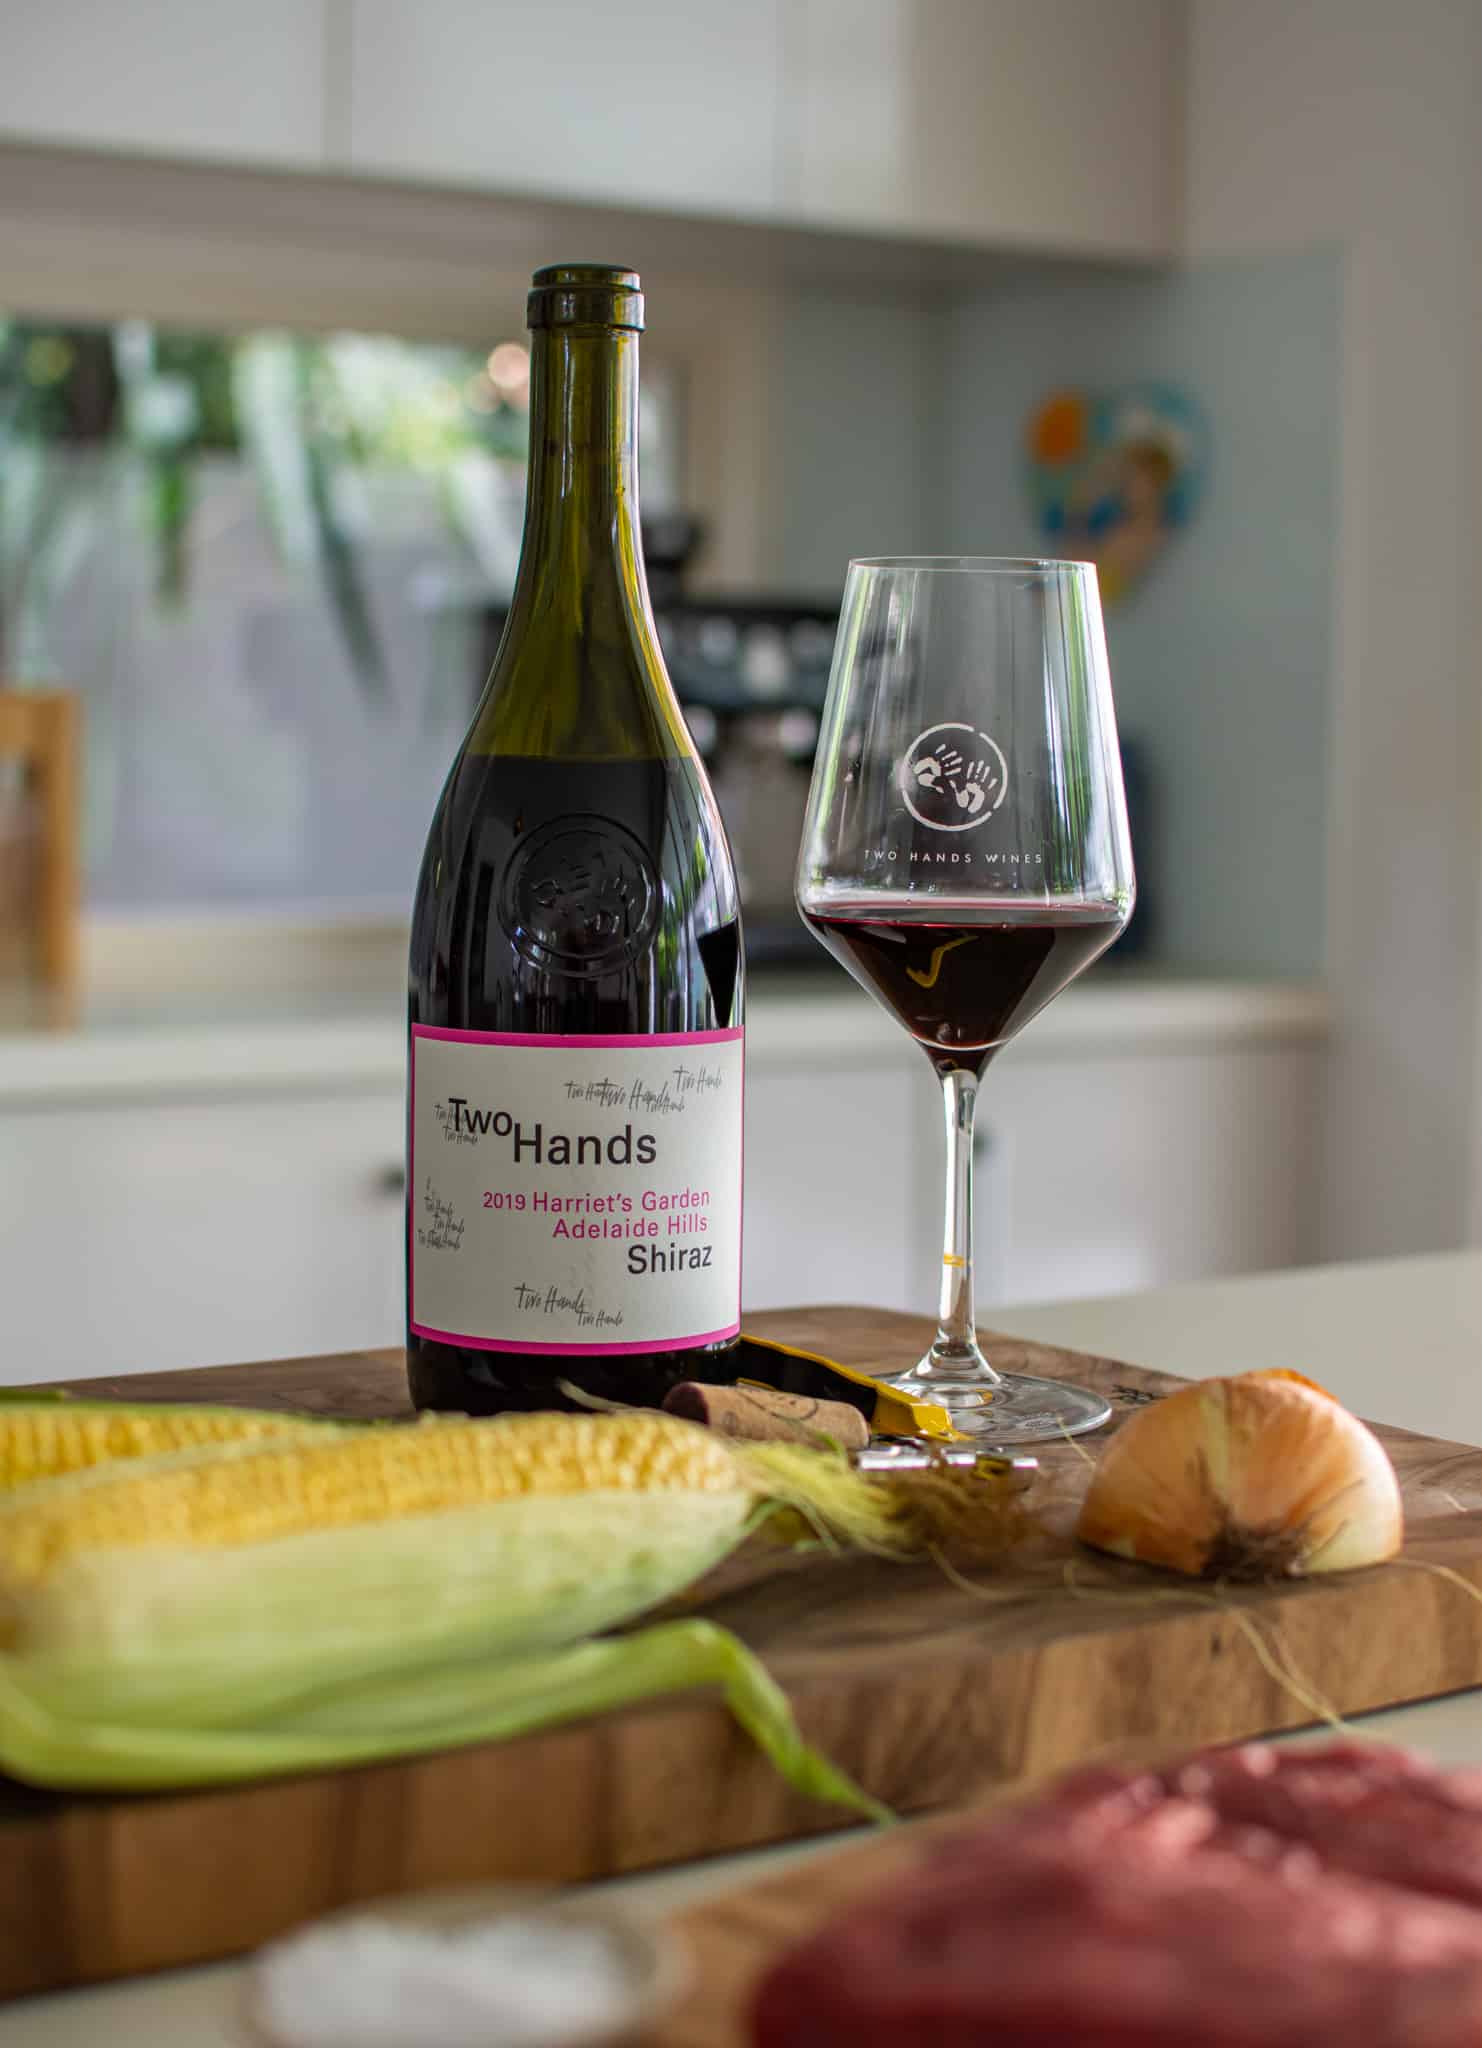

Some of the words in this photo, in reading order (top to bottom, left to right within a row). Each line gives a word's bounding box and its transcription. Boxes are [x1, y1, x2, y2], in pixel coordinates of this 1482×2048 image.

[864, 849, 897, 860] TWO
[909, 851, 972, 863] HANDS
[985, 853, 1043, 864] WINES
[448, 1097, 513, 1137] Two
[513, 1122, 657, 1166] Hands
[483, 1192, 526, 1211] 2019
[533, 1191, 632, 1213] Harriet's
[641, 1188, 710, 1211] Garden
[552, 1217, 659, 1240] Adelaide
[667, 1213, 708, 1236] Hills
[627, 1243, 713, 1275] Shiraz
